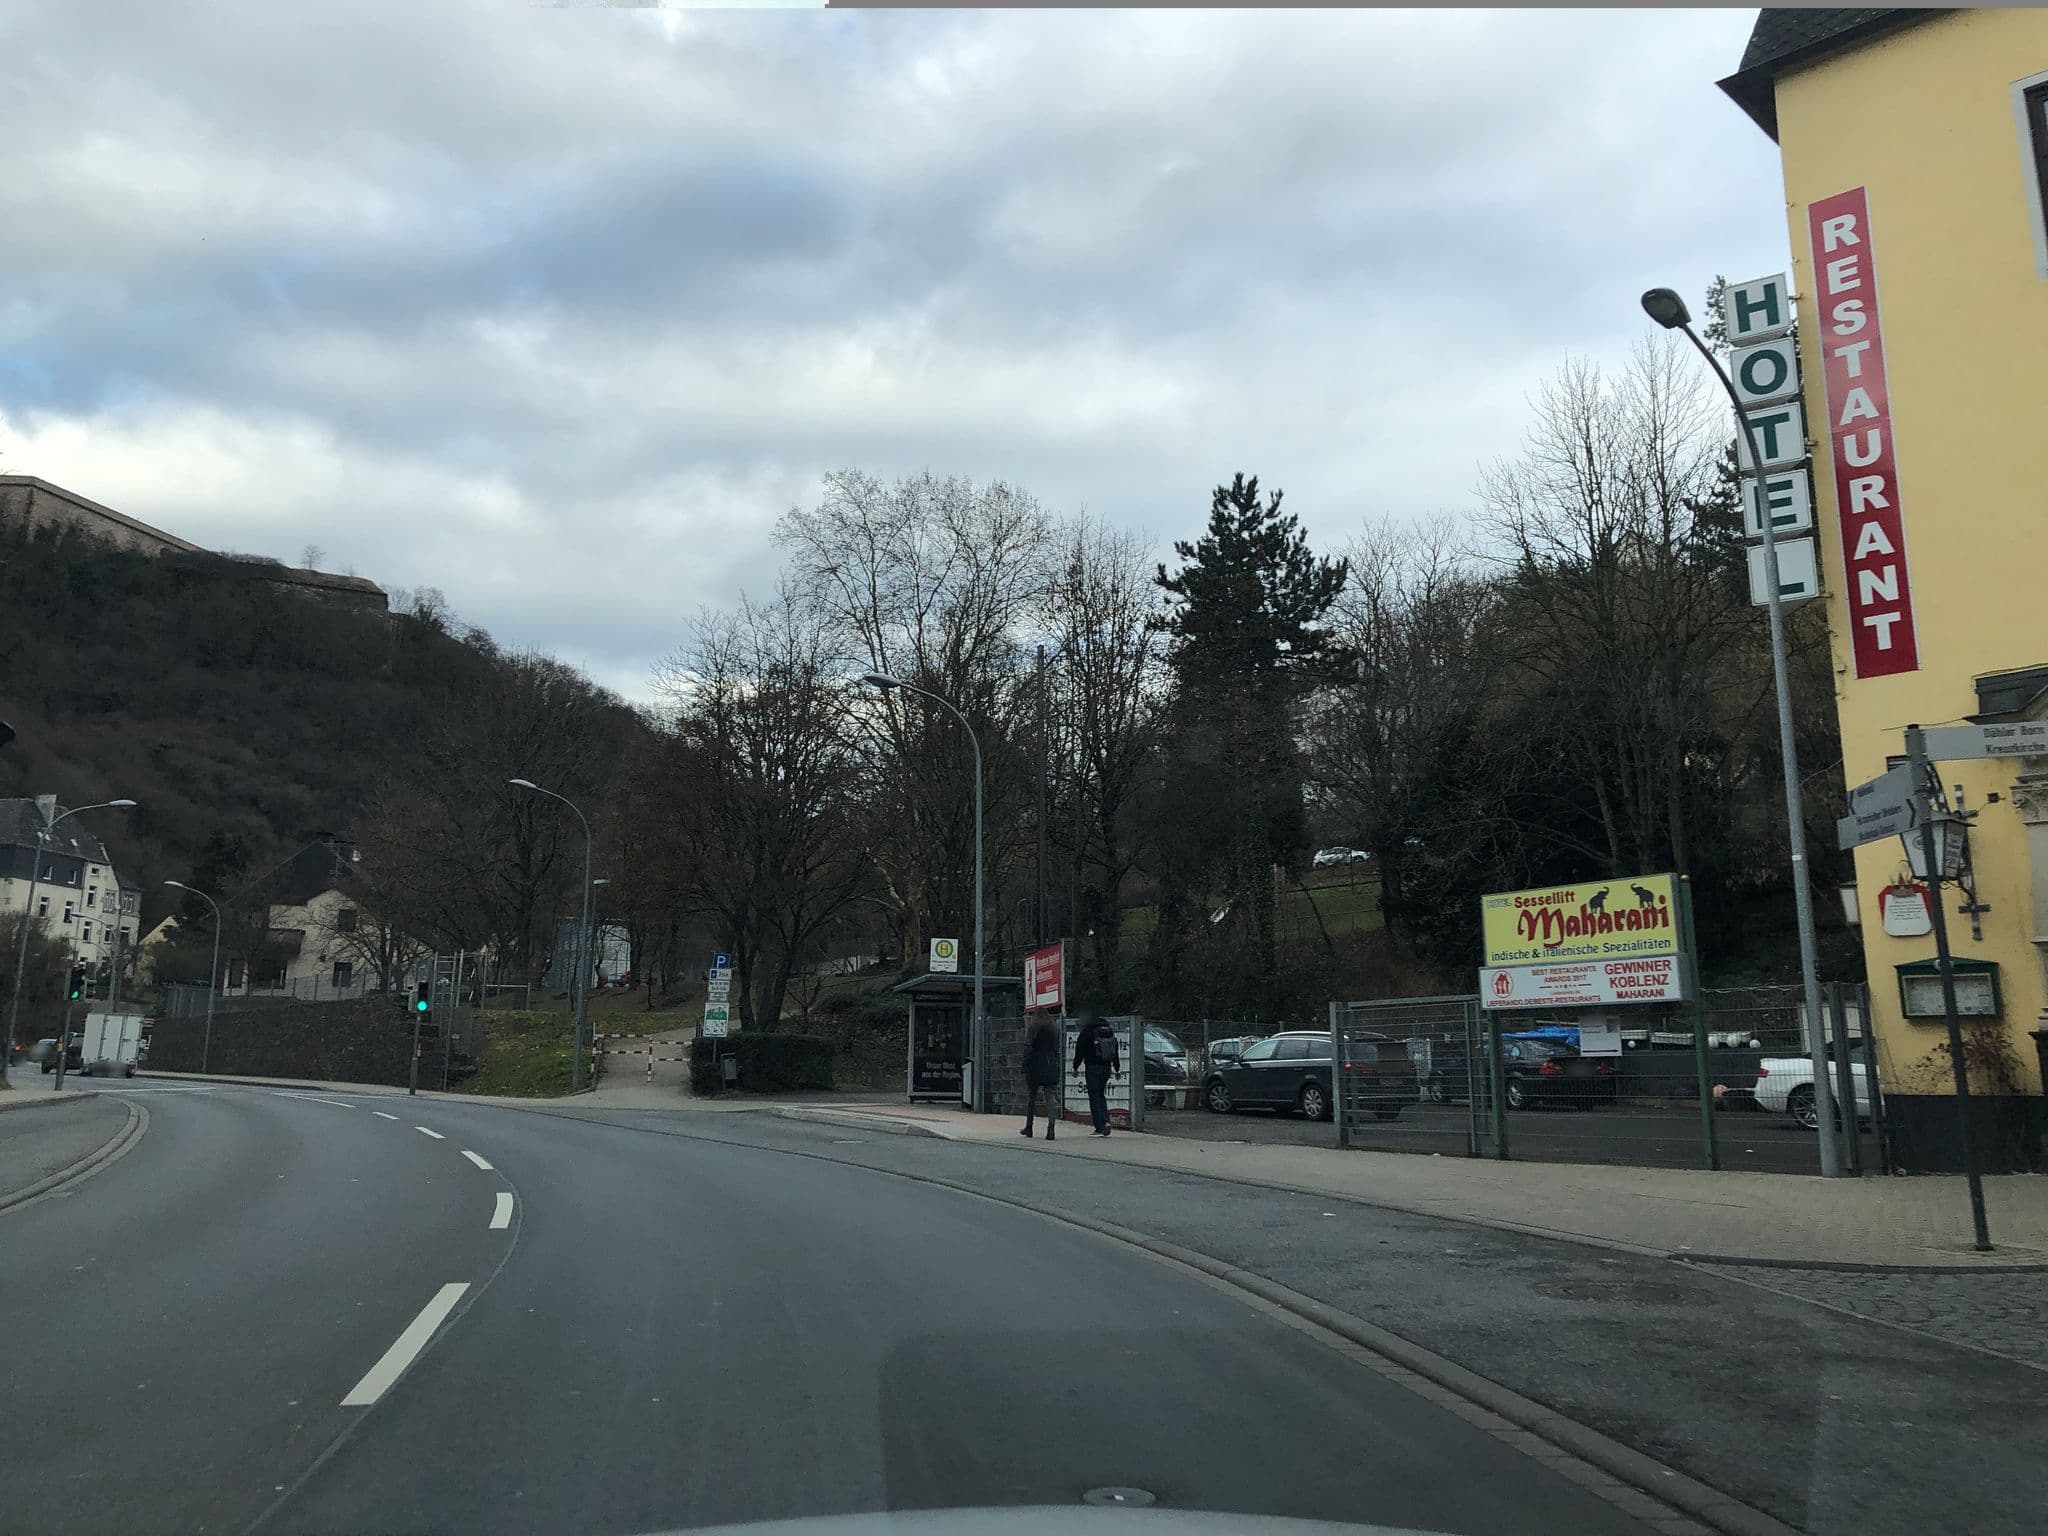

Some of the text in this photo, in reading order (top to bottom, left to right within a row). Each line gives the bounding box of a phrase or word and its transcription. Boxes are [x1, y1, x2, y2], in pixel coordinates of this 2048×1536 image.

[1734, 282, 1805, 596] HOTEL
[1821, 213, 1901, 652] RESTAURANT
[1515, 891, 1576, 908] Sessellift
[1517, 894, 1670, 948] Maharani
[1491, 938, 1671, 962] indische & italienische Spezialitäten
[717, 956, 726, 968] P
[1604, 959, 1672, 976] GEWINNER
[1609, 974, 1669, 989] KOBLENZ
[1616, 989, 1665, 1000] MAHARANI
